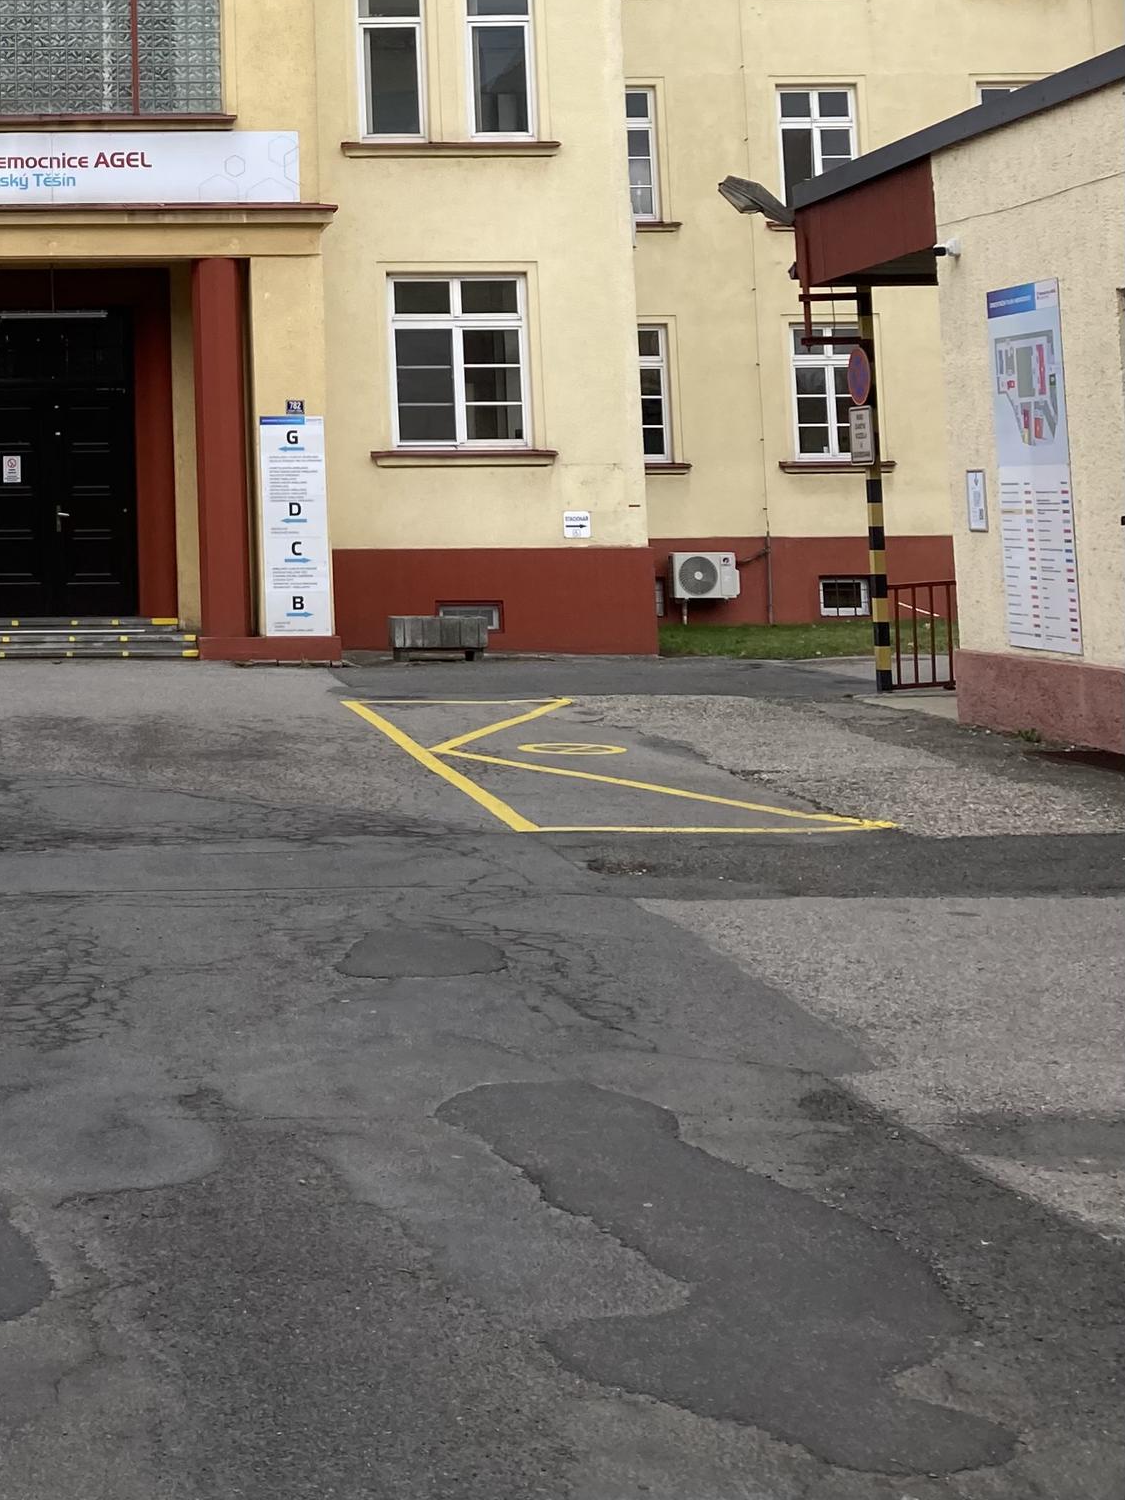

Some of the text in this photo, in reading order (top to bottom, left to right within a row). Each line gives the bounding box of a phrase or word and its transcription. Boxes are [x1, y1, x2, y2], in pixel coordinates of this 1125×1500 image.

[93, 152, 153, 169] AGEL
[32, 171, 76, 187] Těšín
[289, 401, 302, 410] 782
[286, 430, 299, 445] G
[288, 502, 302, 516] D
[291, 541, 303, 556] C
[292, 596, 304, 610] B
